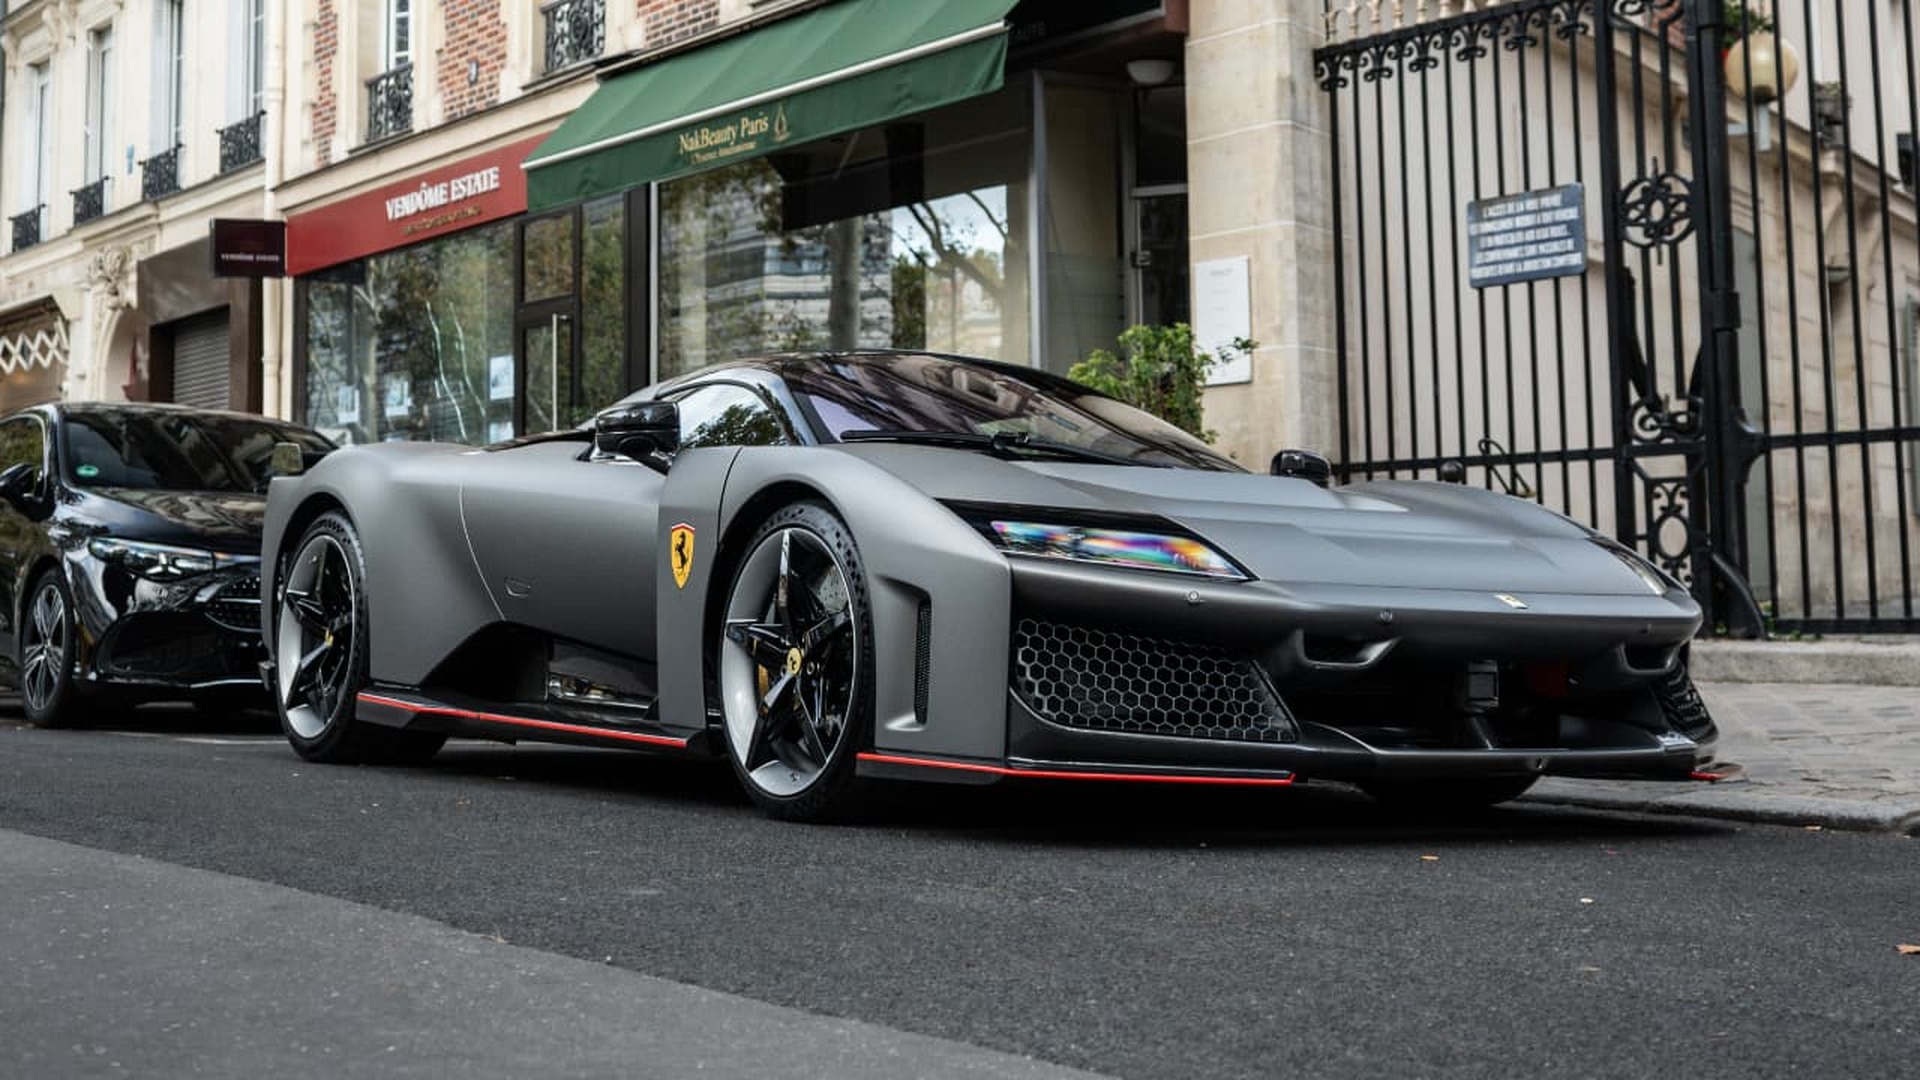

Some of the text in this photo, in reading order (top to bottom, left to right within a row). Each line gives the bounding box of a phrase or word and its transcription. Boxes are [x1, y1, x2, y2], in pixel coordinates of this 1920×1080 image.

[740, 111, 769, 138] Paris
[385, 181, 449, 221] VENDÔME
[450, 165, 500, 201] ESTATE
